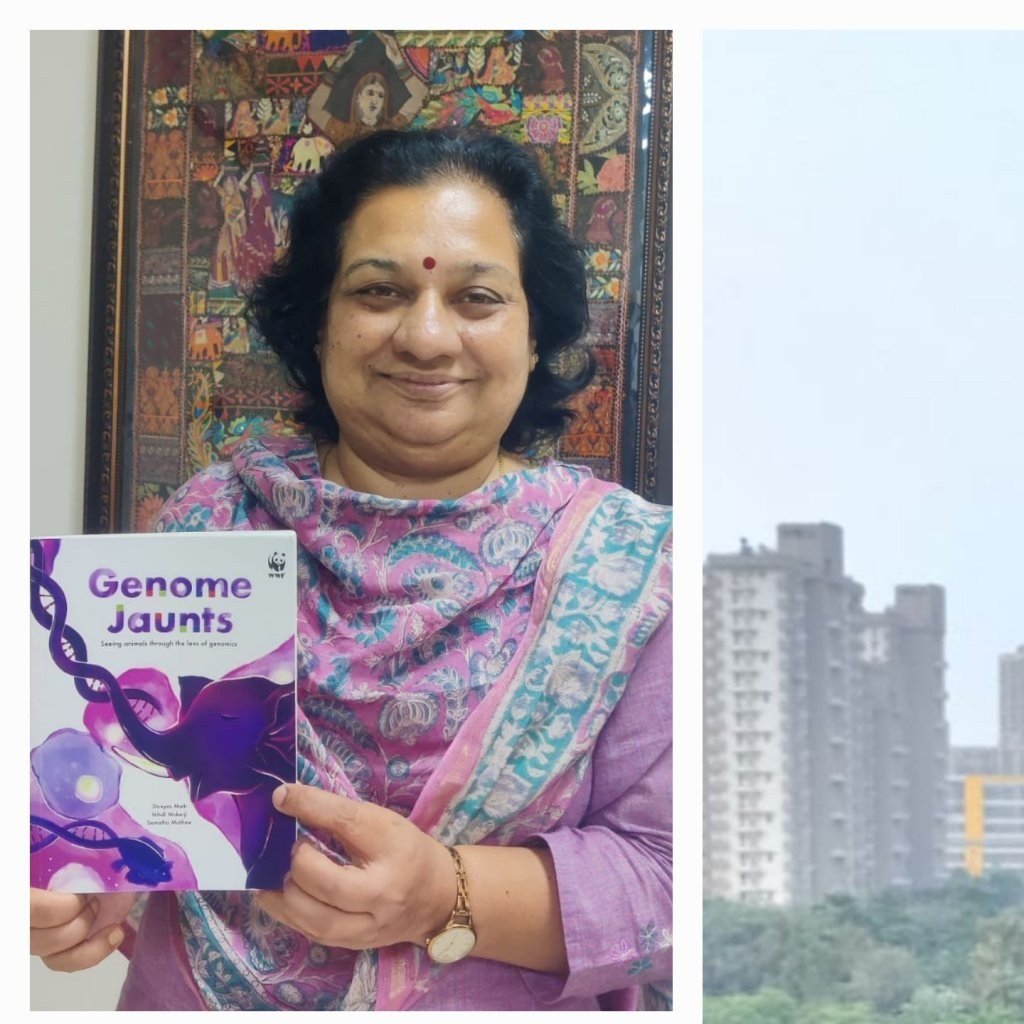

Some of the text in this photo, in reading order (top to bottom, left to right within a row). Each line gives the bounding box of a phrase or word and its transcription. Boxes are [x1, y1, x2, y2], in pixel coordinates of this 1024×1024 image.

[89, 568, 251, 599] Genome
[107, 604, 233, 634] Jaunts
[100, 640, 121, 648] Seeing
[149, 640, 173, 648] through
